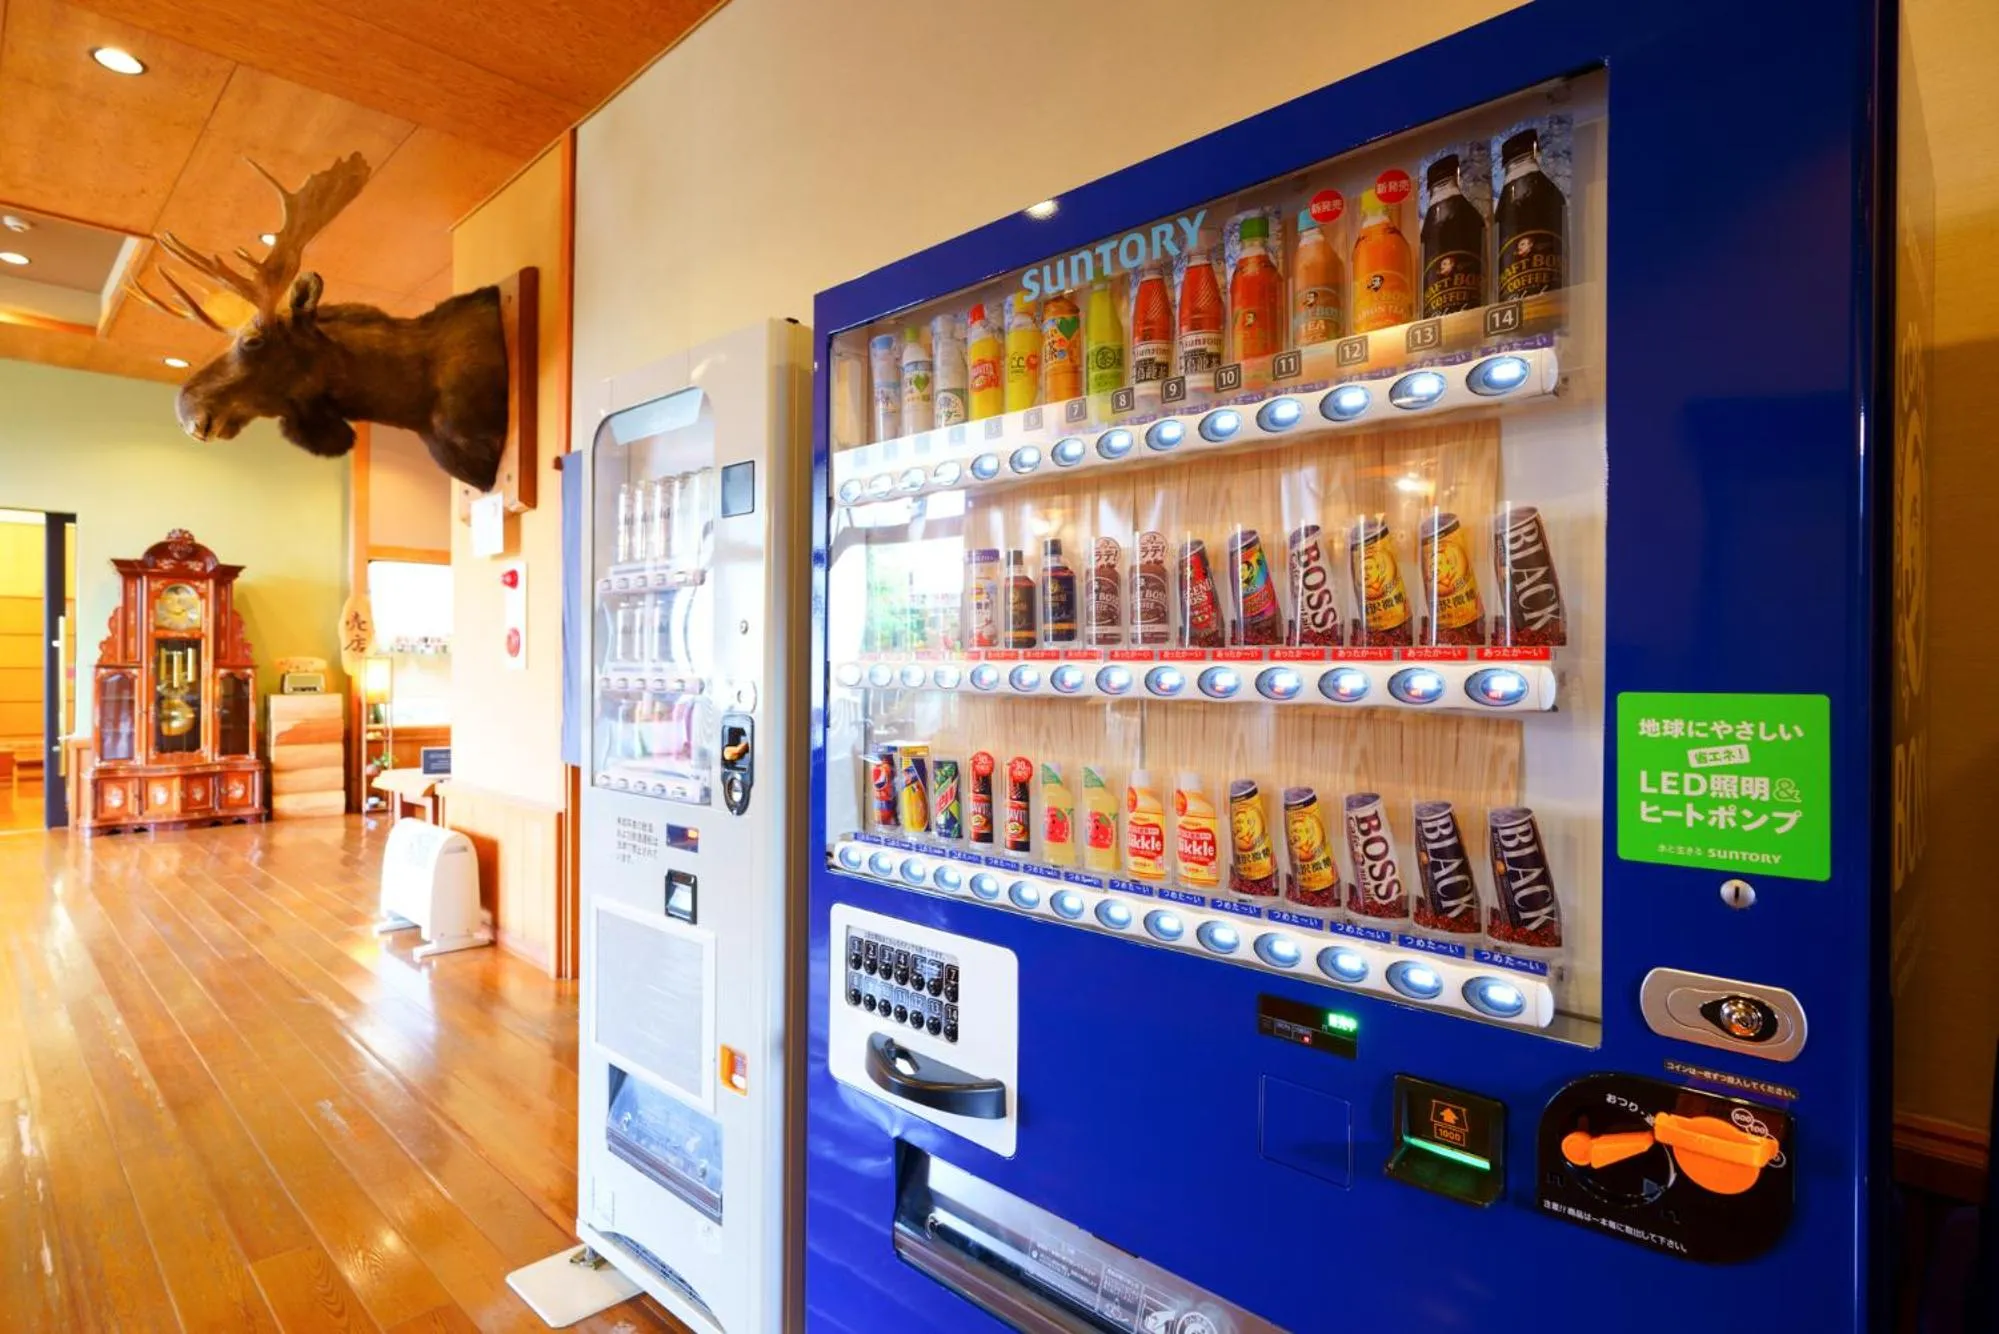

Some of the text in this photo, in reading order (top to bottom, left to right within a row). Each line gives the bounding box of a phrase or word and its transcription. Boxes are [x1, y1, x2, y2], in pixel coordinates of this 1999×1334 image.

[1022, 209, 1207, 302] SUNTORY
[1492, 310, 1514, 328] 14
[1414, 327, 1433, 344] 13
[1343, 343, 1360, 359] 12
[1280, 358, 1296, 372] 11
[1221, 371, 1235, 385] 10
[1169, 383, 1178, 396] 9
[1119, 394, 1127, 407] 8
[1072, 404, 1079, 417] 7
[1507, 518, 1561, 631] BLACK
[1297, 541, 1337, 629] BOSS
[1638, 718, 1804, 741] 地球にやさしい
[1640, 801, 1803, 834] ヒートポンプ
[1355, 809, 1402, 901] BOSS
[1707, 848, 1782, 864] SUNTORY
[1421, 813, 1480, 918] BLACK
[1498, 821, 1557, 931] BLACK
[1438, 1128, 1461, 1141] 1000
